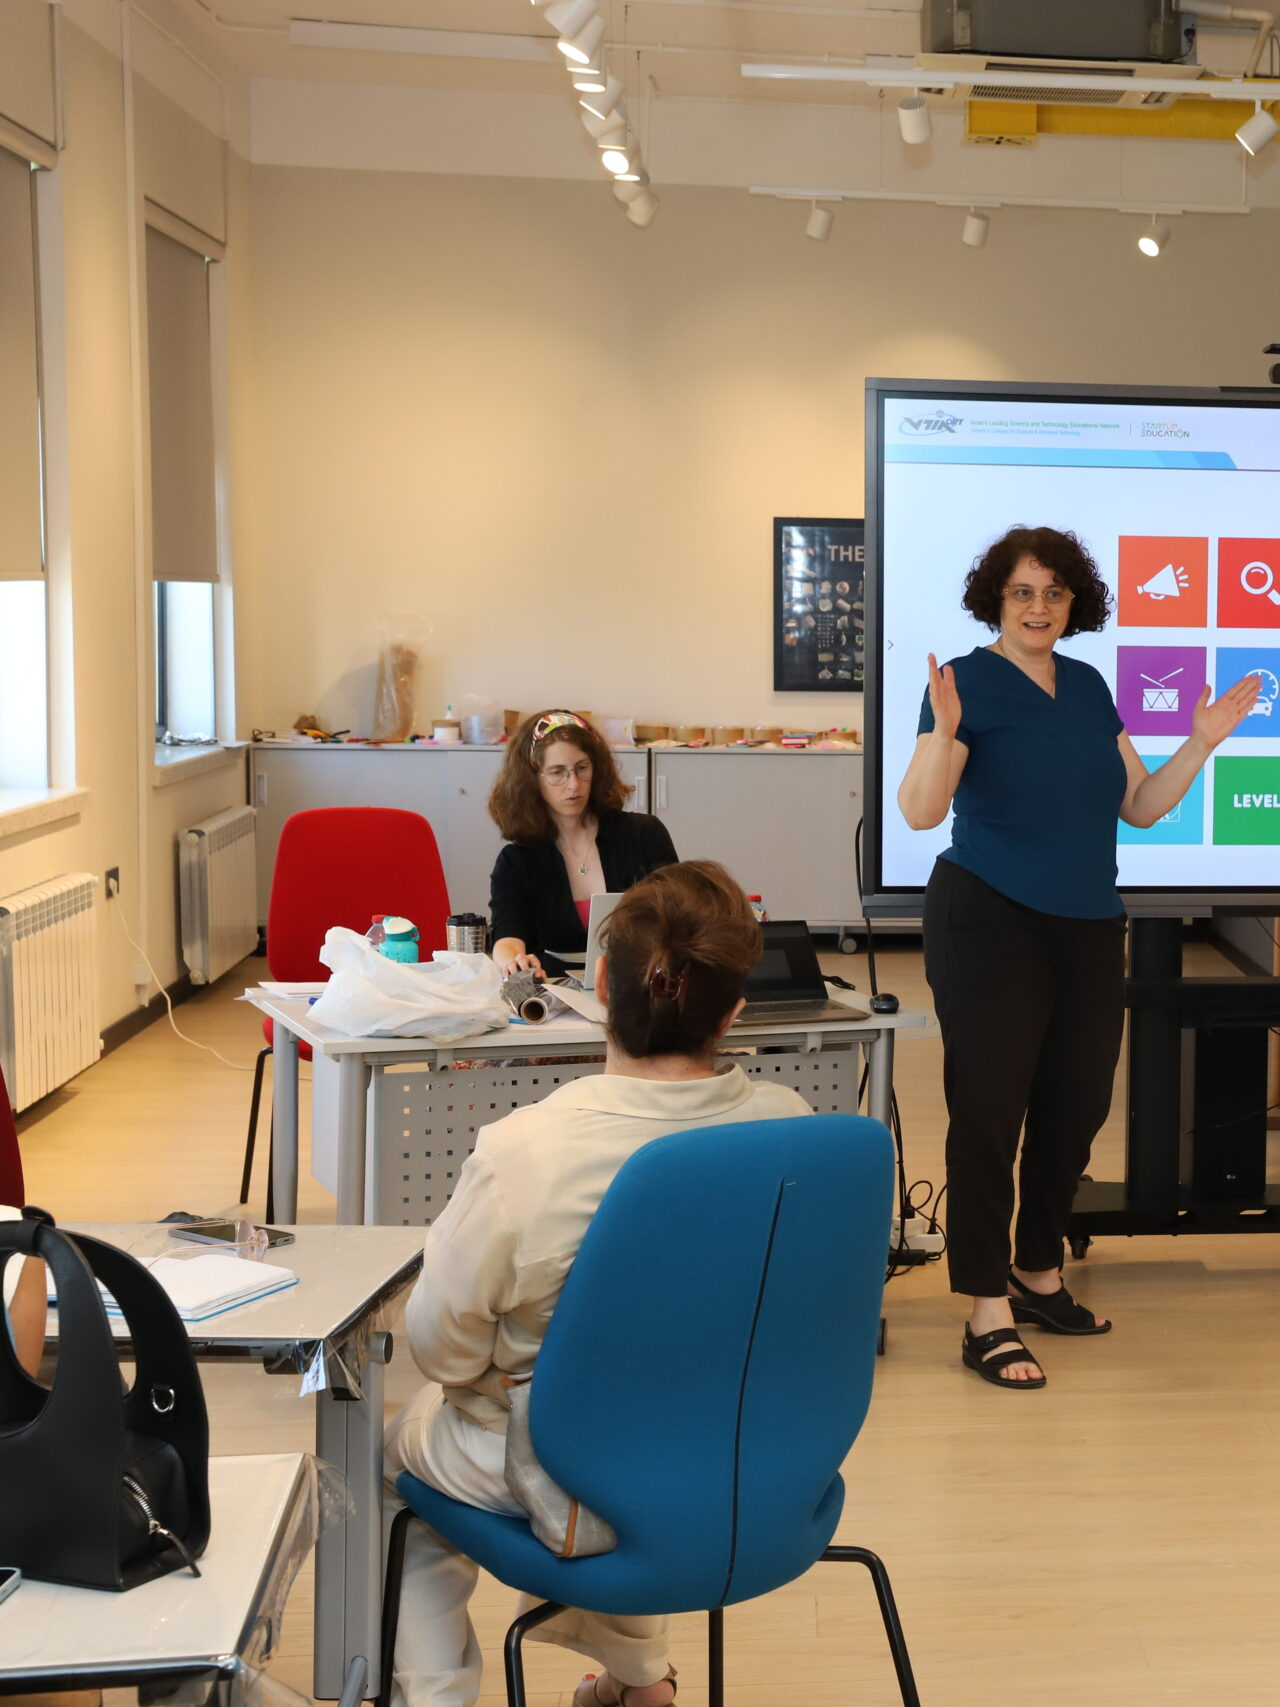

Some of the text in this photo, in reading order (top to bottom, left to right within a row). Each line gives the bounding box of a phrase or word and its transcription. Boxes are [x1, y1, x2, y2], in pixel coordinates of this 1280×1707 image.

[1141, 422, 1178, 430] STARTUP
[1141, 428, 1190, 438] EDUCATION
[827, 544, 865, 562] THE
